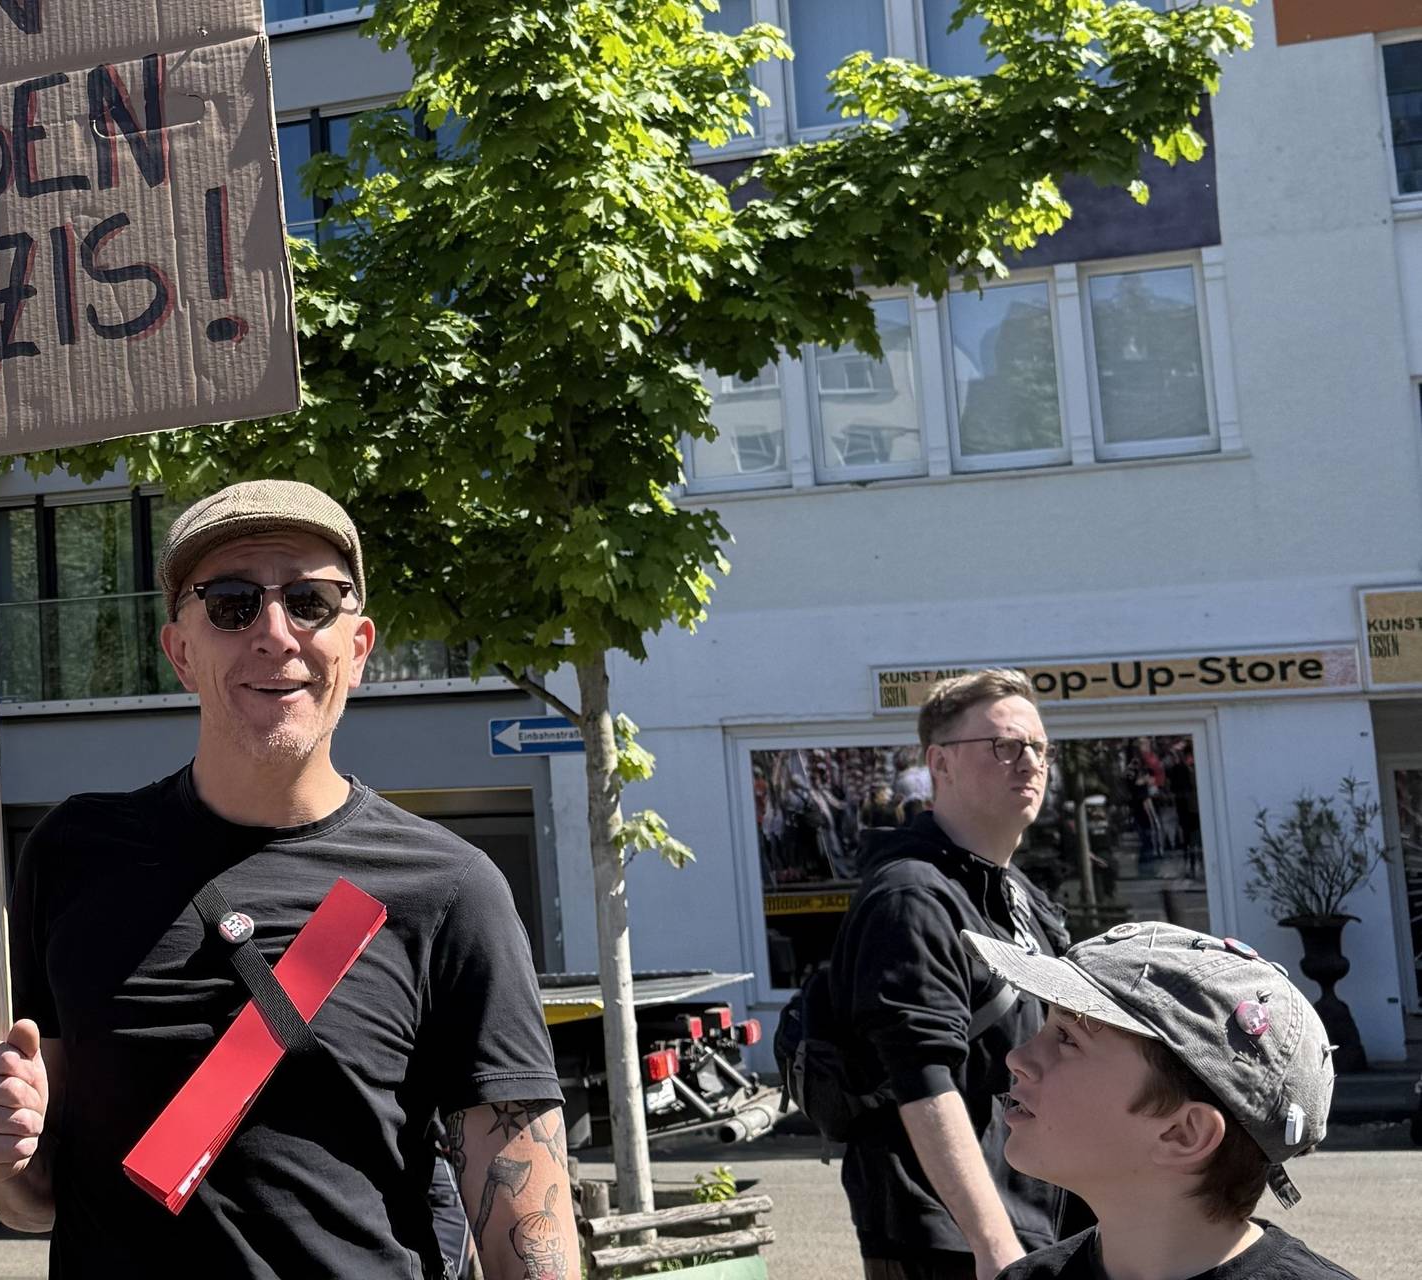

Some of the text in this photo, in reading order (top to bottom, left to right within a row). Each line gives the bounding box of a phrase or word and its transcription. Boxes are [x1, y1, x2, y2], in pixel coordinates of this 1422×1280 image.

[879, 671, 929, 684] KUNST
[1028, 656, 1324, 699] op-Up-Store
[518, 729, 582, 741] Einbahnstraß
